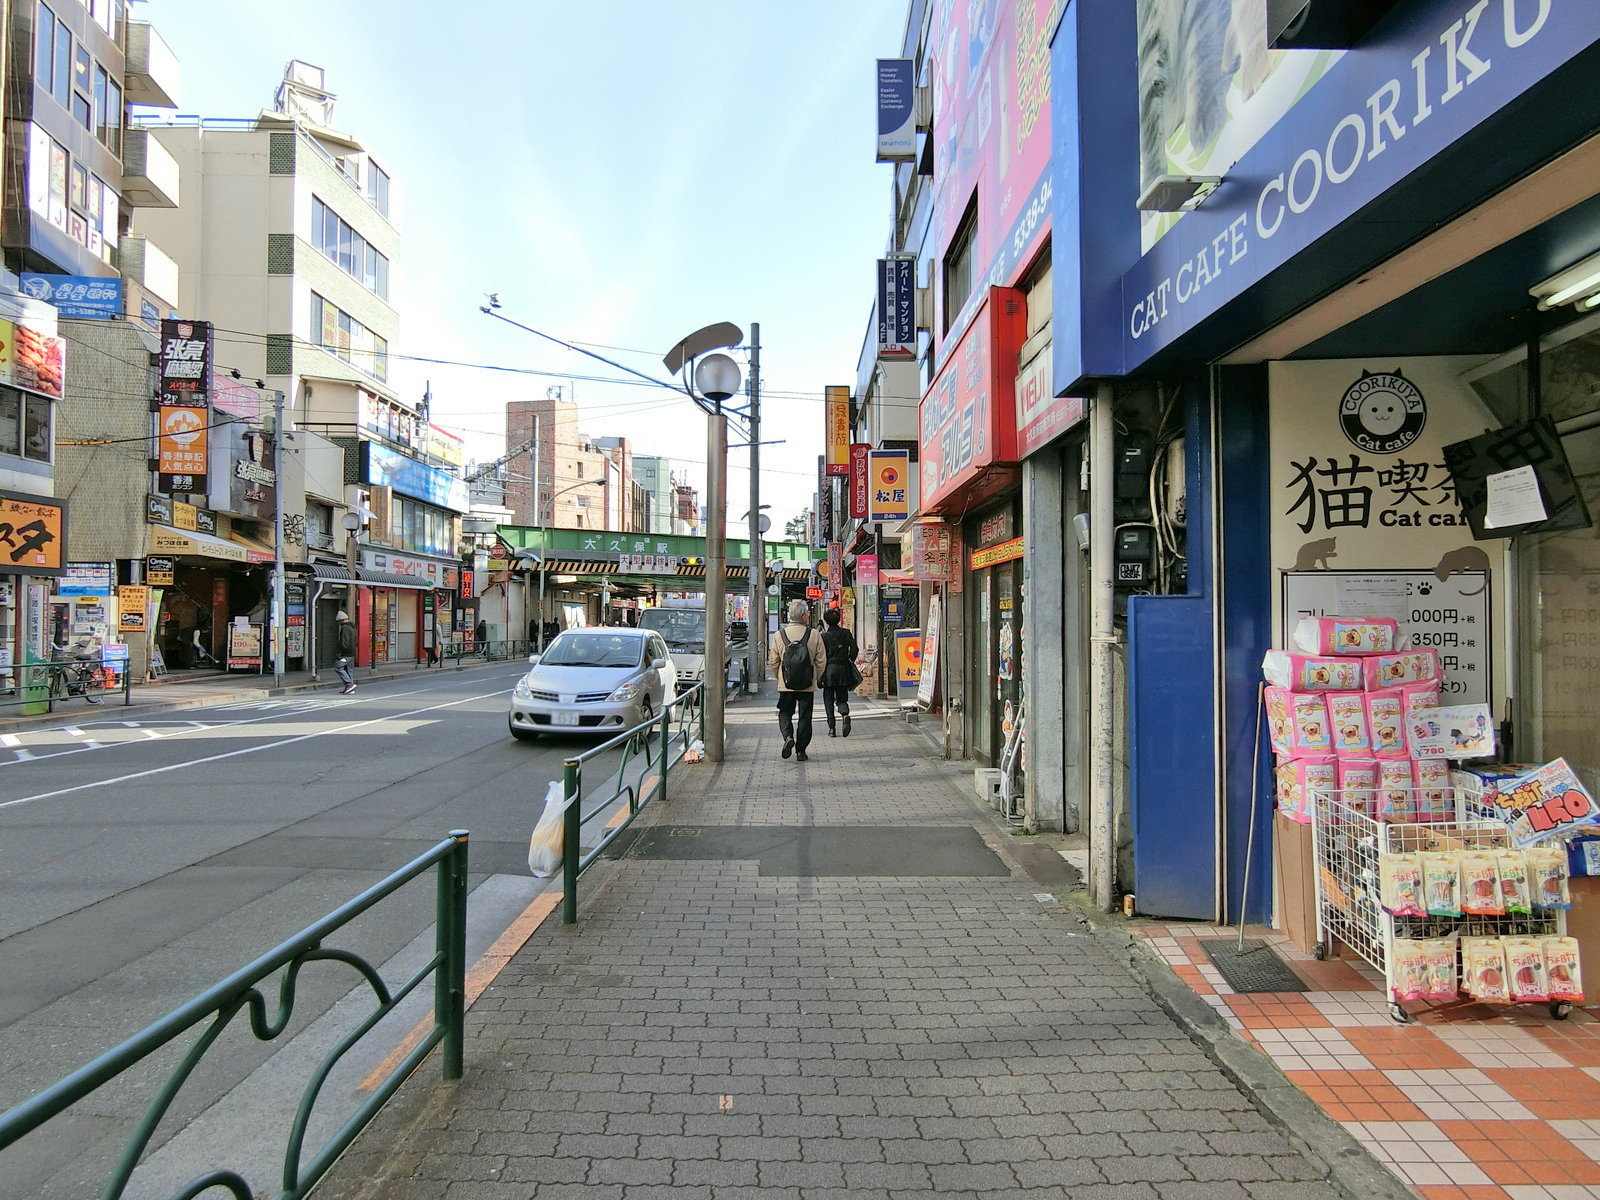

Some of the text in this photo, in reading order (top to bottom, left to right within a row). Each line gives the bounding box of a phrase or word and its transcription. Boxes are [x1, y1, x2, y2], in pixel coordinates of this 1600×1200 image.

[1130, 277, 1173, 340] CAT
[1175, 211, 1248, 305] CAFE
[880, 322, 886, 342] 2F
[163, 338, 206, 361] 张亮
[163, 393, 178, 404] 2F
[1344, 375, 1421, 412] COORIKUYA
[1355, 429, 1415, 451] Cat cafe
[162, 452, 204, 462] 香港華記
[162, 462, 204, 473] 人気点心
[172, 475, 193, 485] 香港
[875, 489, 905, 503] 松屋
[1379, 509, 1421, 527] Cat
[922, 527, 948, 538] 印鑑
[584, 538, 668, 553] 大久保駅
[620, 555, 676, 566] 大型最徐行
[1412, 632, 1458, 647] 350円
[1440, 656, 1458, 671] 円
